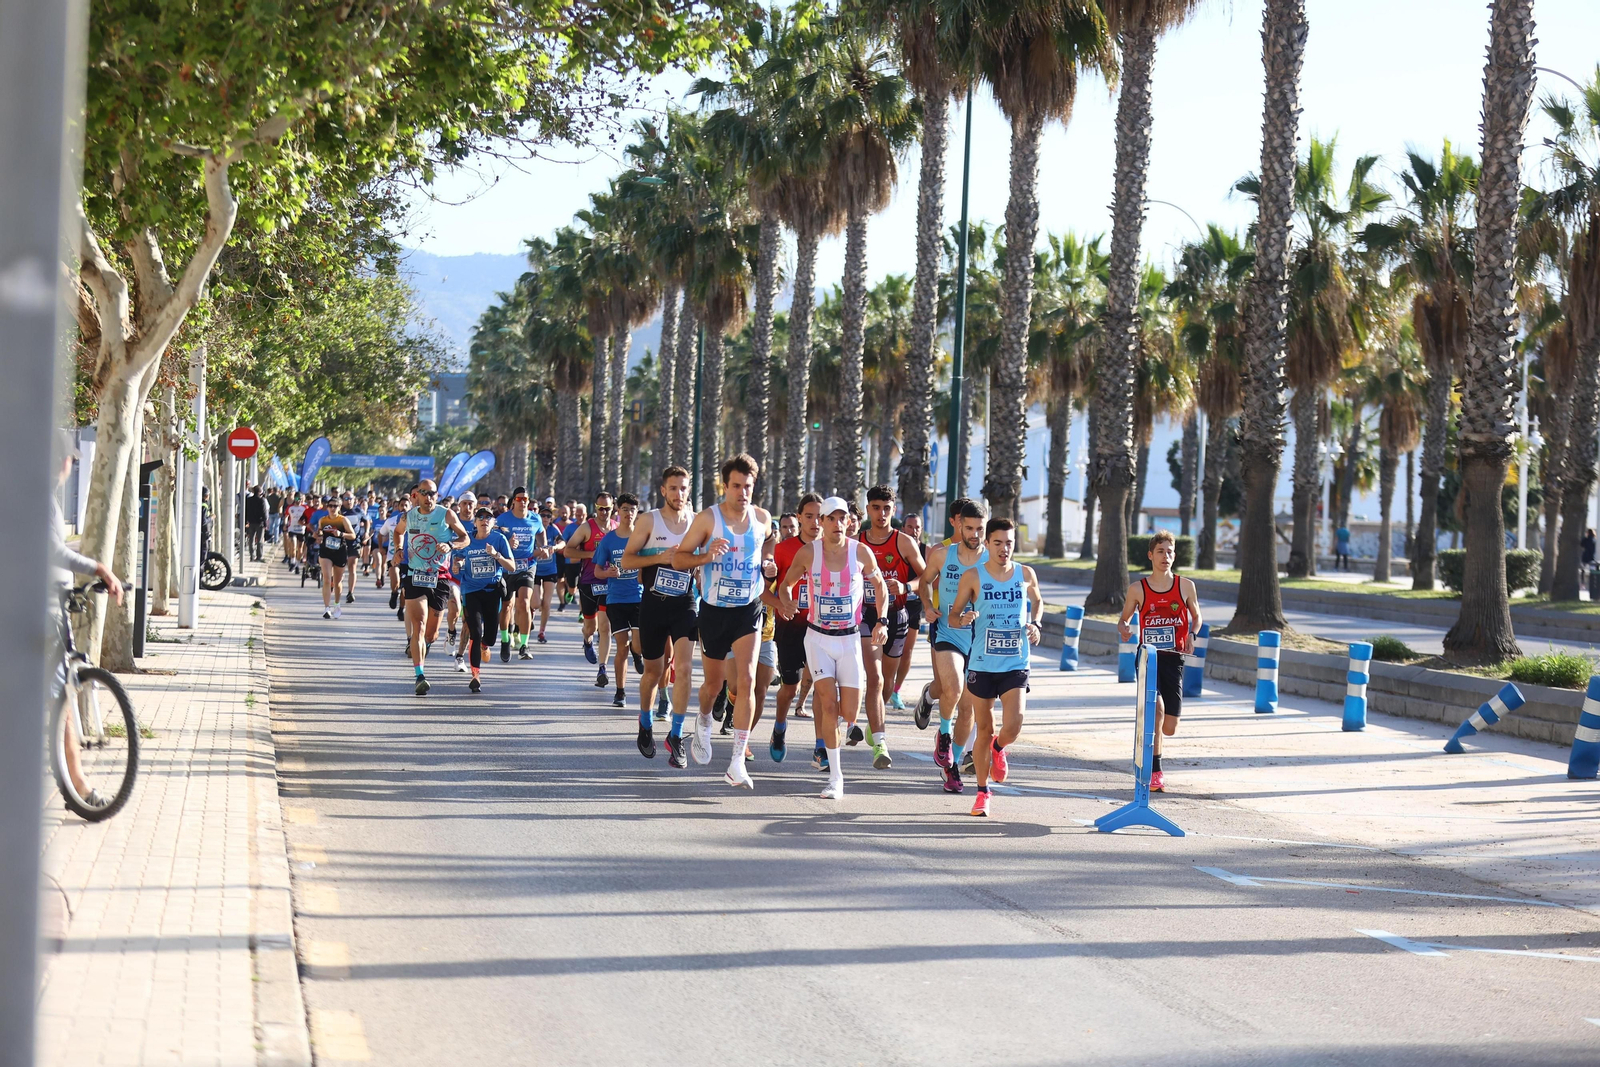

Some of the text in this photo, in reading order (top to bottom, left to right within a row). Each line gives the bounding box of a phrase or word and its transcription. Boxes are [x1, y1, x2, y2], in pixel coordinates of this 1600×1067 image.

[304, 446, 325, 481] mayoral
[454, 458, 488, 491] mayoral
[660, 578, 685, 590] 1992
[728, 588, 741, 596] 26
[984, 588, 1022, 602] nerja
[829, 605, 843, 614] 25
[990, 639, 1018, 647] 2156
